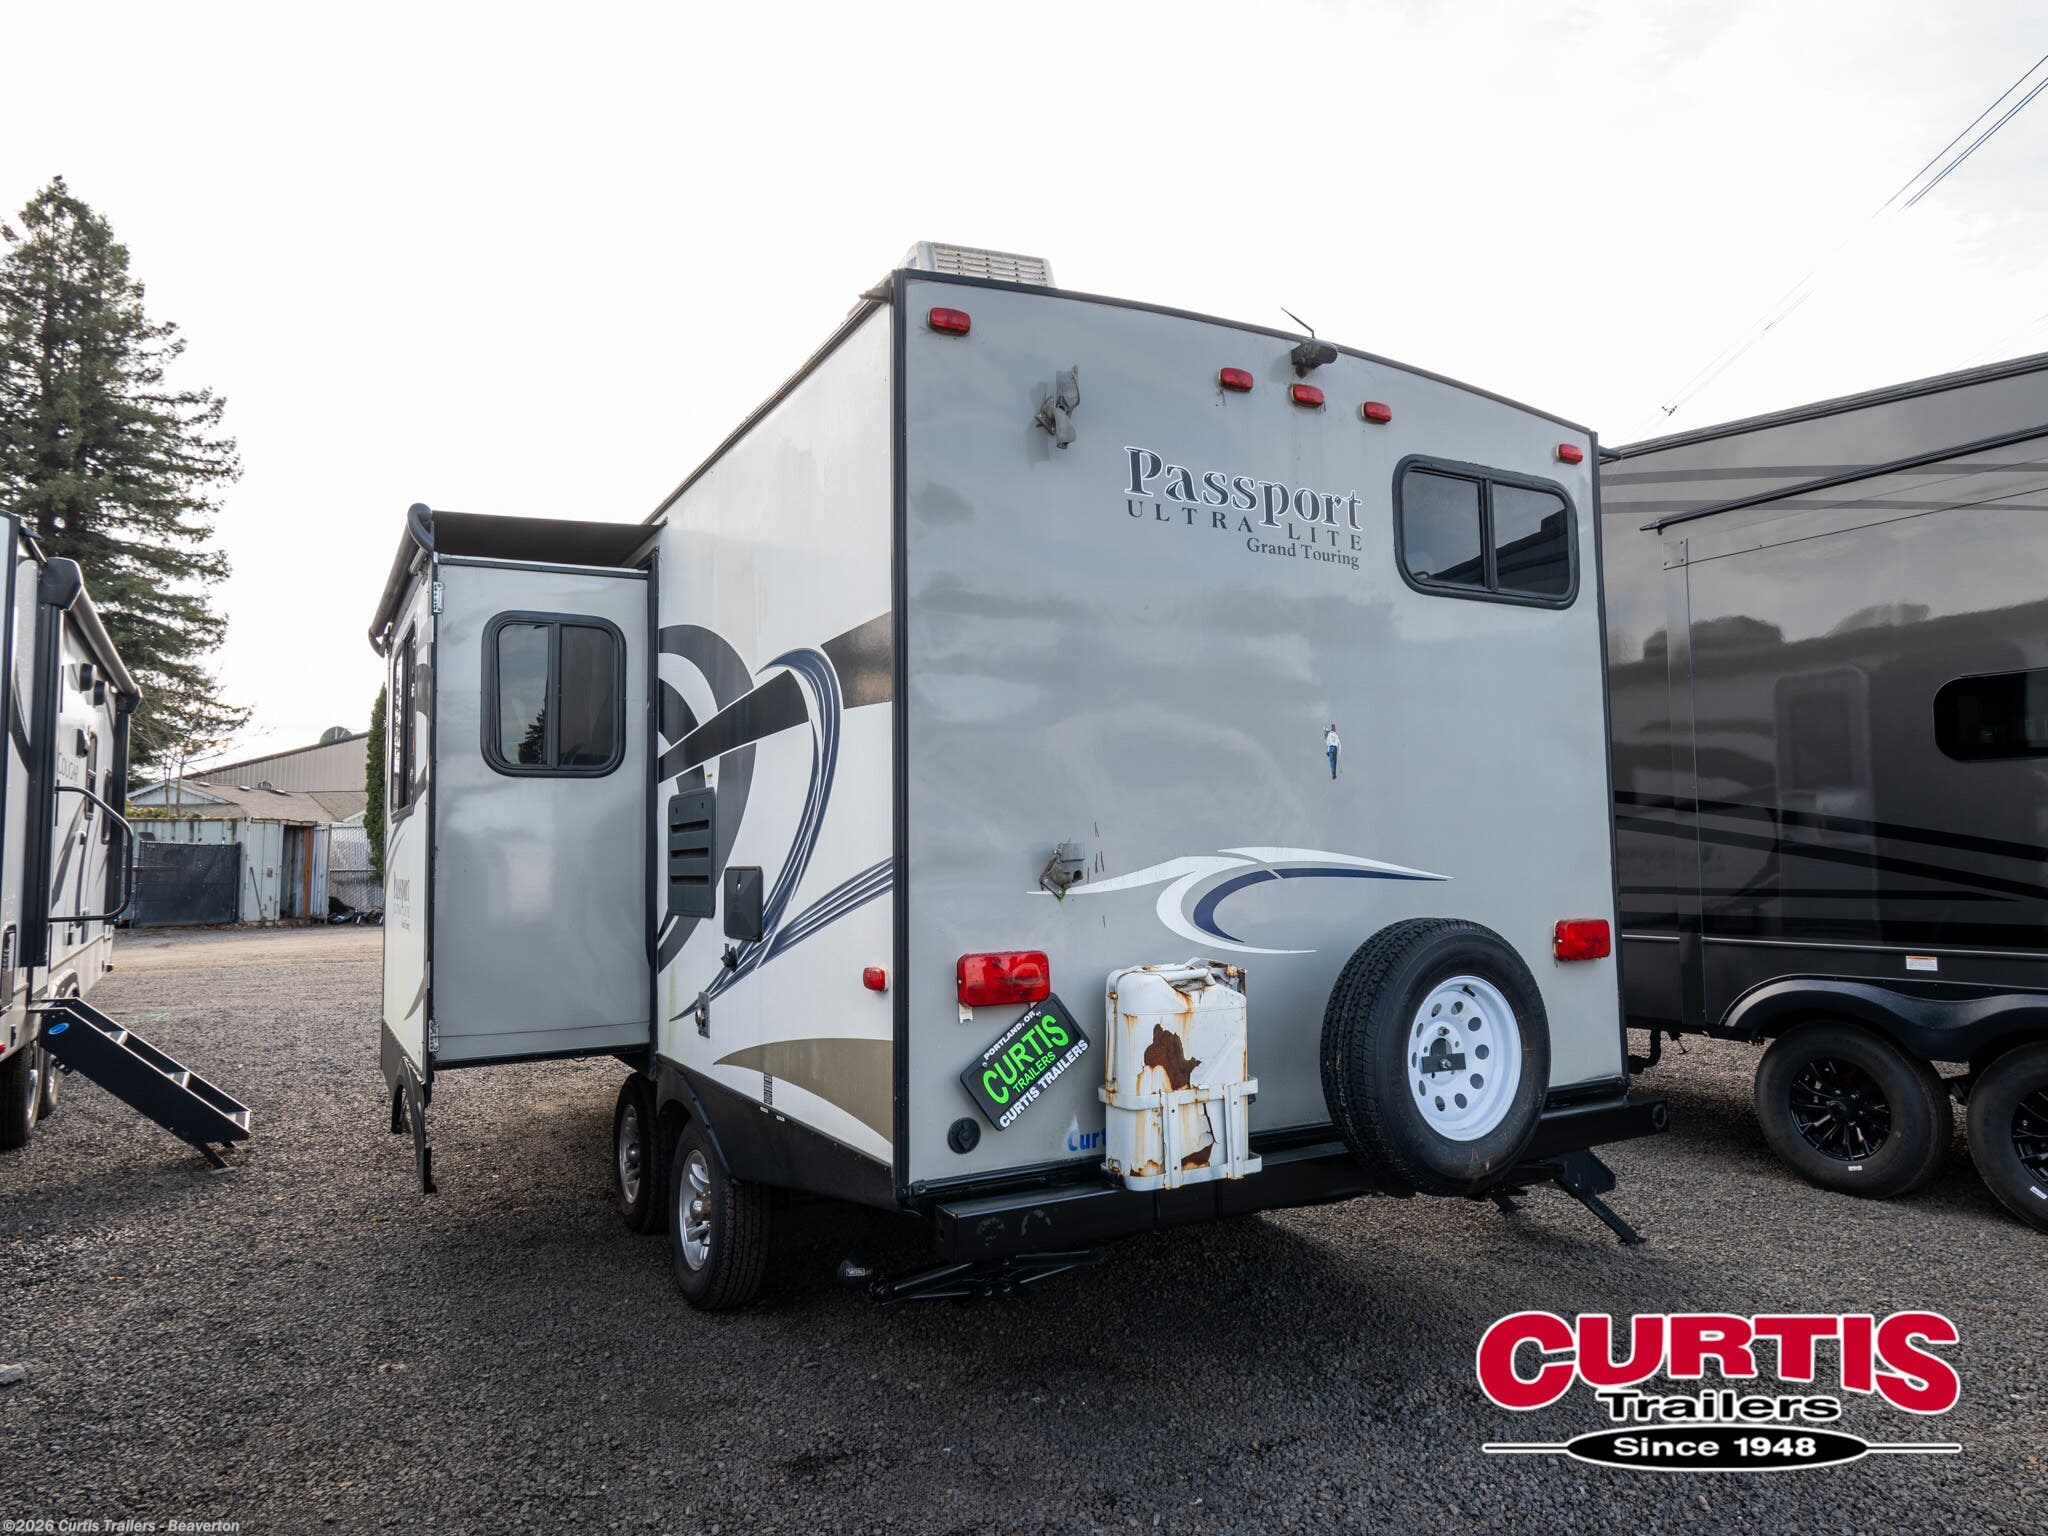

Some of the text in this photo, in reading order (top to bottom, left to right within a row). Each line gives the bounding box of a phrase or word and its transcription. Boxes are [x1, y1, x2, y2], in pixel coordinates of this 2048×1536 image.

[1124, 446, 1363, 530] Passport
[1126, 499, 1362, 551] ULTRA LITE
[1246, 537, 1360, 570] Grand Touring
[982, 1014, 1069, 1105] CURTIS
[983, 1020, 1025, 1061] PORTLAND,
[999, 1039, 1088, 1128] CURTIS TRAILERS
[1013, 1051, 1056, 1093] TRAILERS
